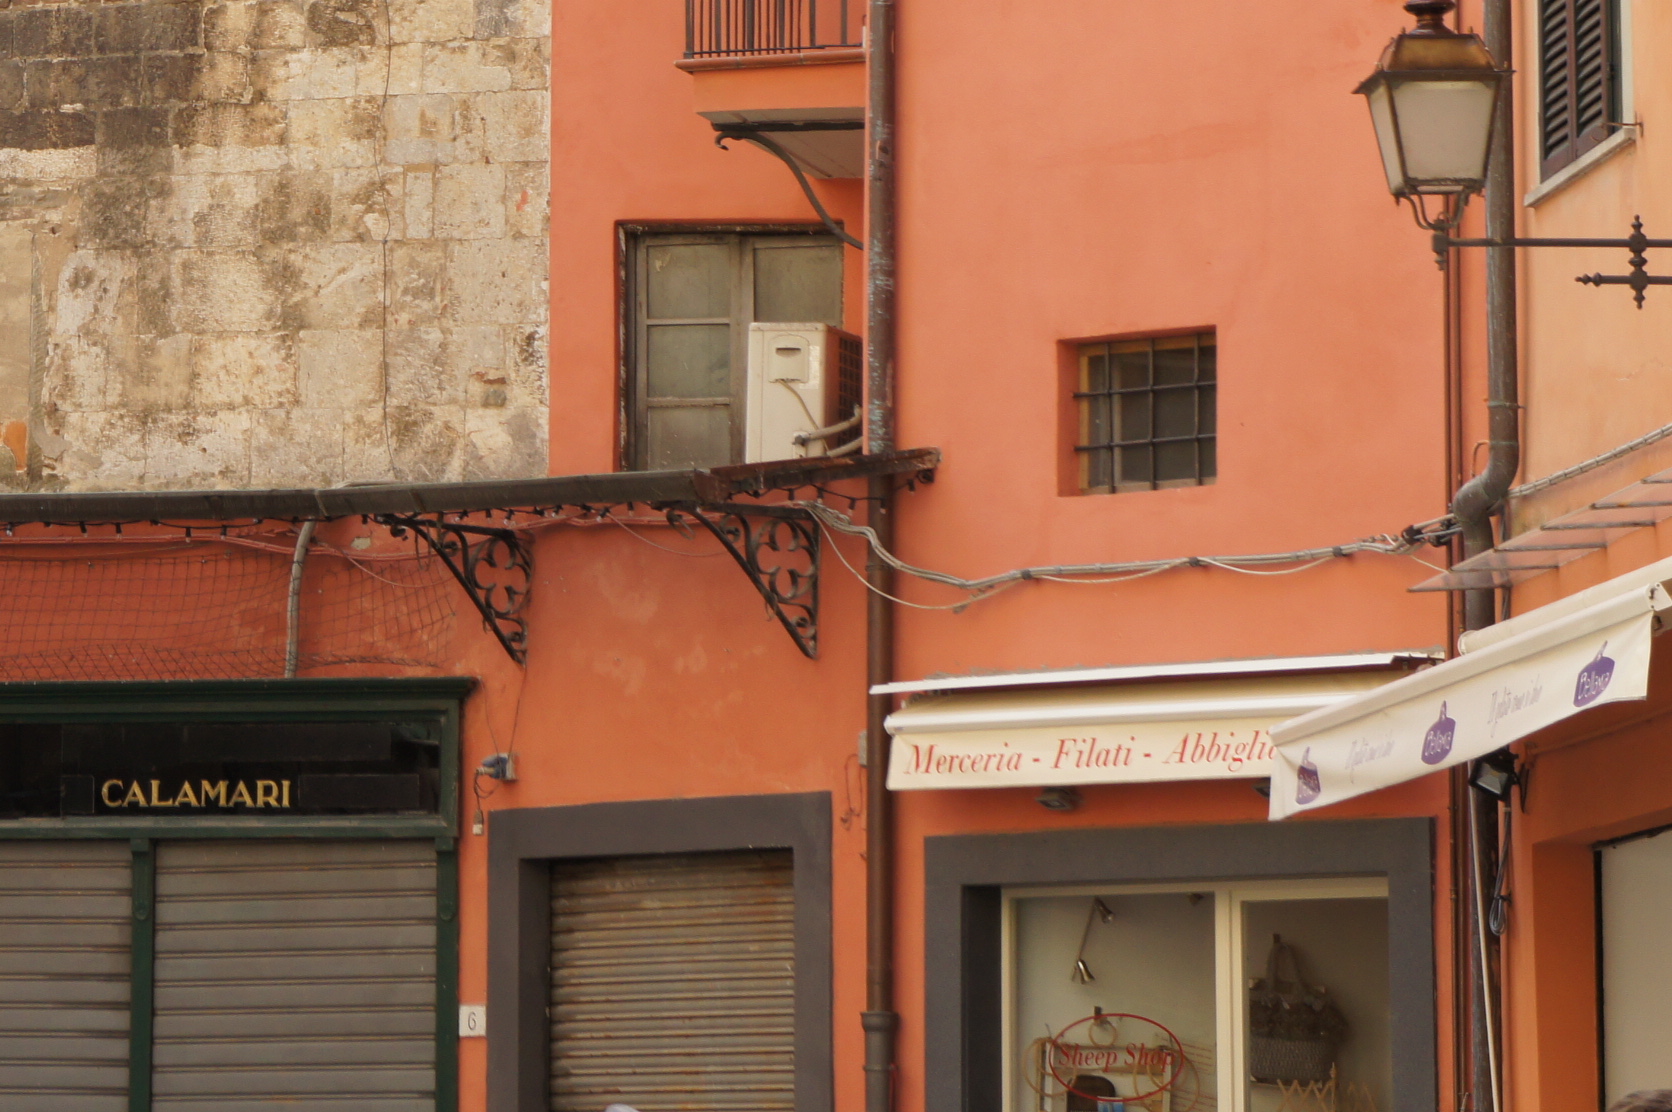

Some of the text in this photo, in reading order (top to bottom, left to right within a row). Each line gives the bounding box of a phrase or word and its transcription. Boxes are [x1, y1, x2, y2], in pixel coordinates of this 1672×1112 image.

[903, 742, 1023, 775] Merceria
[1050, 735, 1137, 769] Filati
[101, 779, 291, 808] CALAMARI
[467, 1010, 477, 1031] 6
[1058, 1043, 1118, 1073] Sheep
[1123, 1042, 1177, 1074] Shop
